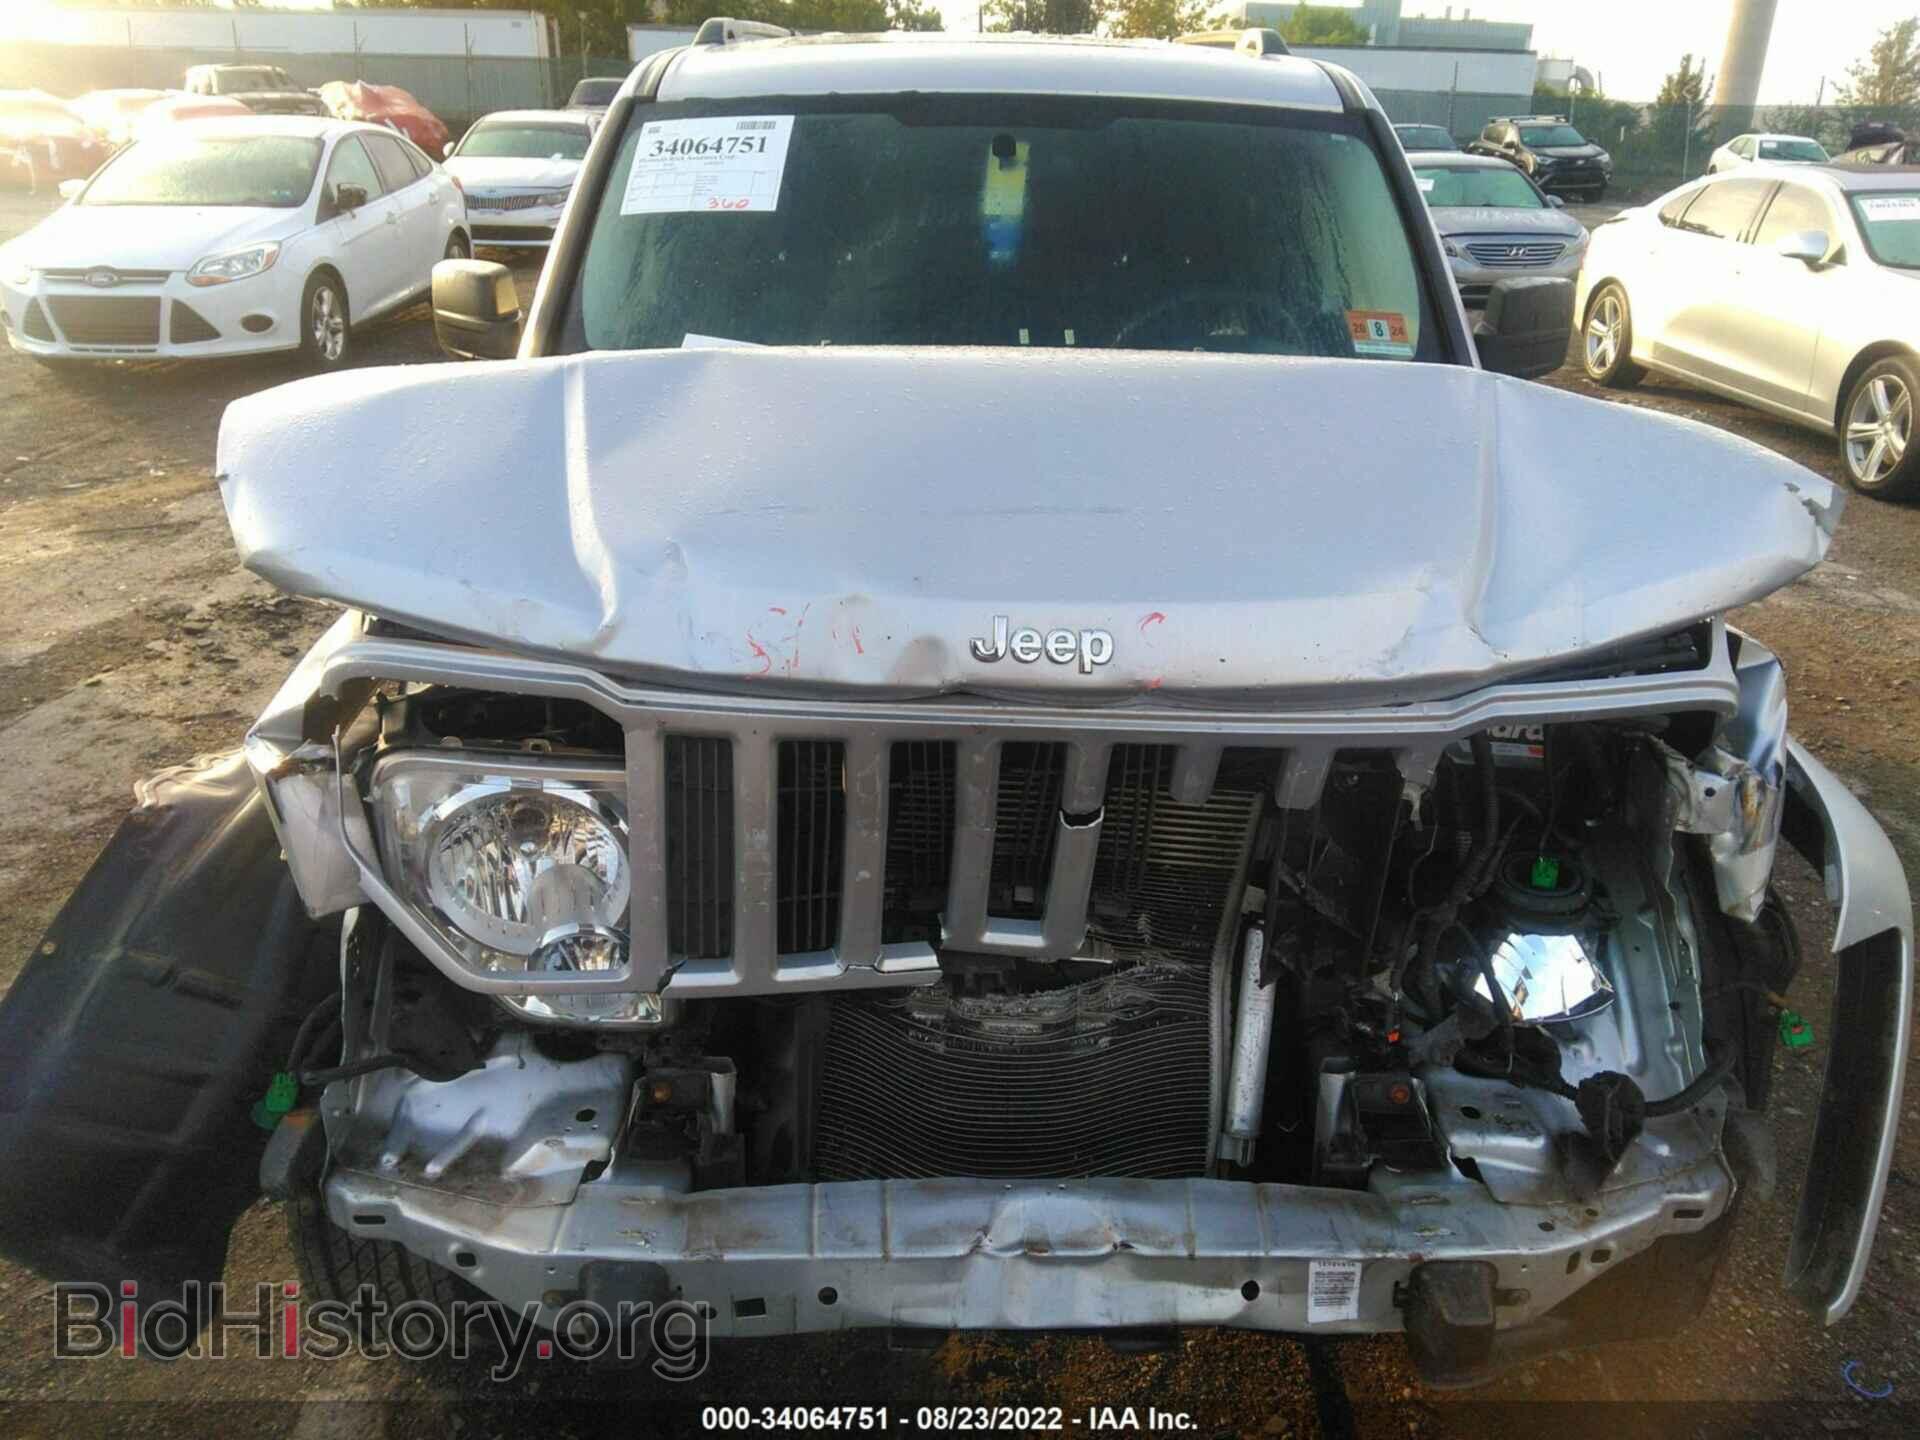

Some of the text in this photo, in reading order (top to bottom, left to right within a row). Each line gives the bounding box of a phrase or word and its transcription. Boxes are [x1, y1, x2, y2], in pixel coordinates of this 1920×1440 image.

[649, 135, 767, 157] 34064751
[708, 197, 749, 209] 360
[1374, 321, 1385, 337] 8
[969, 615, 1114, 674] Jeep
